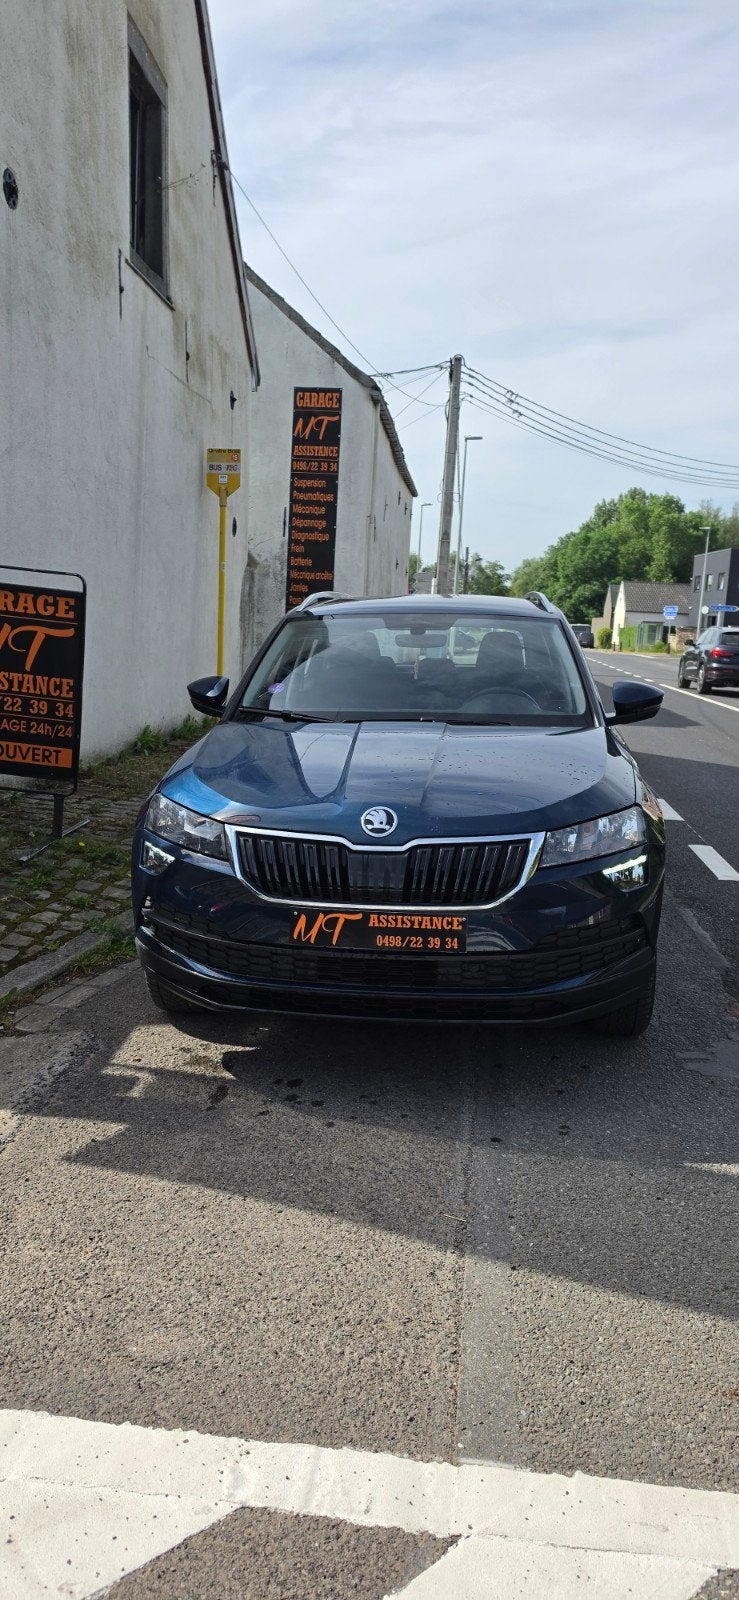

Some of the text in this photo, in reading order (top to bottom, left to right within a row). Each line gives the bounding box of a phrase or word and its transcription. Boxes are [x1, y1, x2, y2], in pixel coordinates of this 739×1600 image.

[296, 392, 340, 408] GARAGE
[293, 415, 340, 441] MT
[293, 445, 338, 457] ASSISTANCE
[292, 461, 337, 472] 0498/22 39 34
[293, 477, 326, 488] Suspension
[292, 490, 334, 502] Pneumatiques
[292, 503, 326, 516] Mécanique
[291, 516, 327, 529] Dépannage
[291, 530, 330, 542] Diagnostique
[290, 556, 312, 567] Batterie
[0, 590, 75, 618] RAGE
[29, 699, 48, 715] 39
[55, 702, 74, 718] 34
[30, 721, 73, 739] 24h/24
[293, 912, 463, 946] MT ASSISTANCE
[376, 934, 458, 949] 0498/22 39 34
